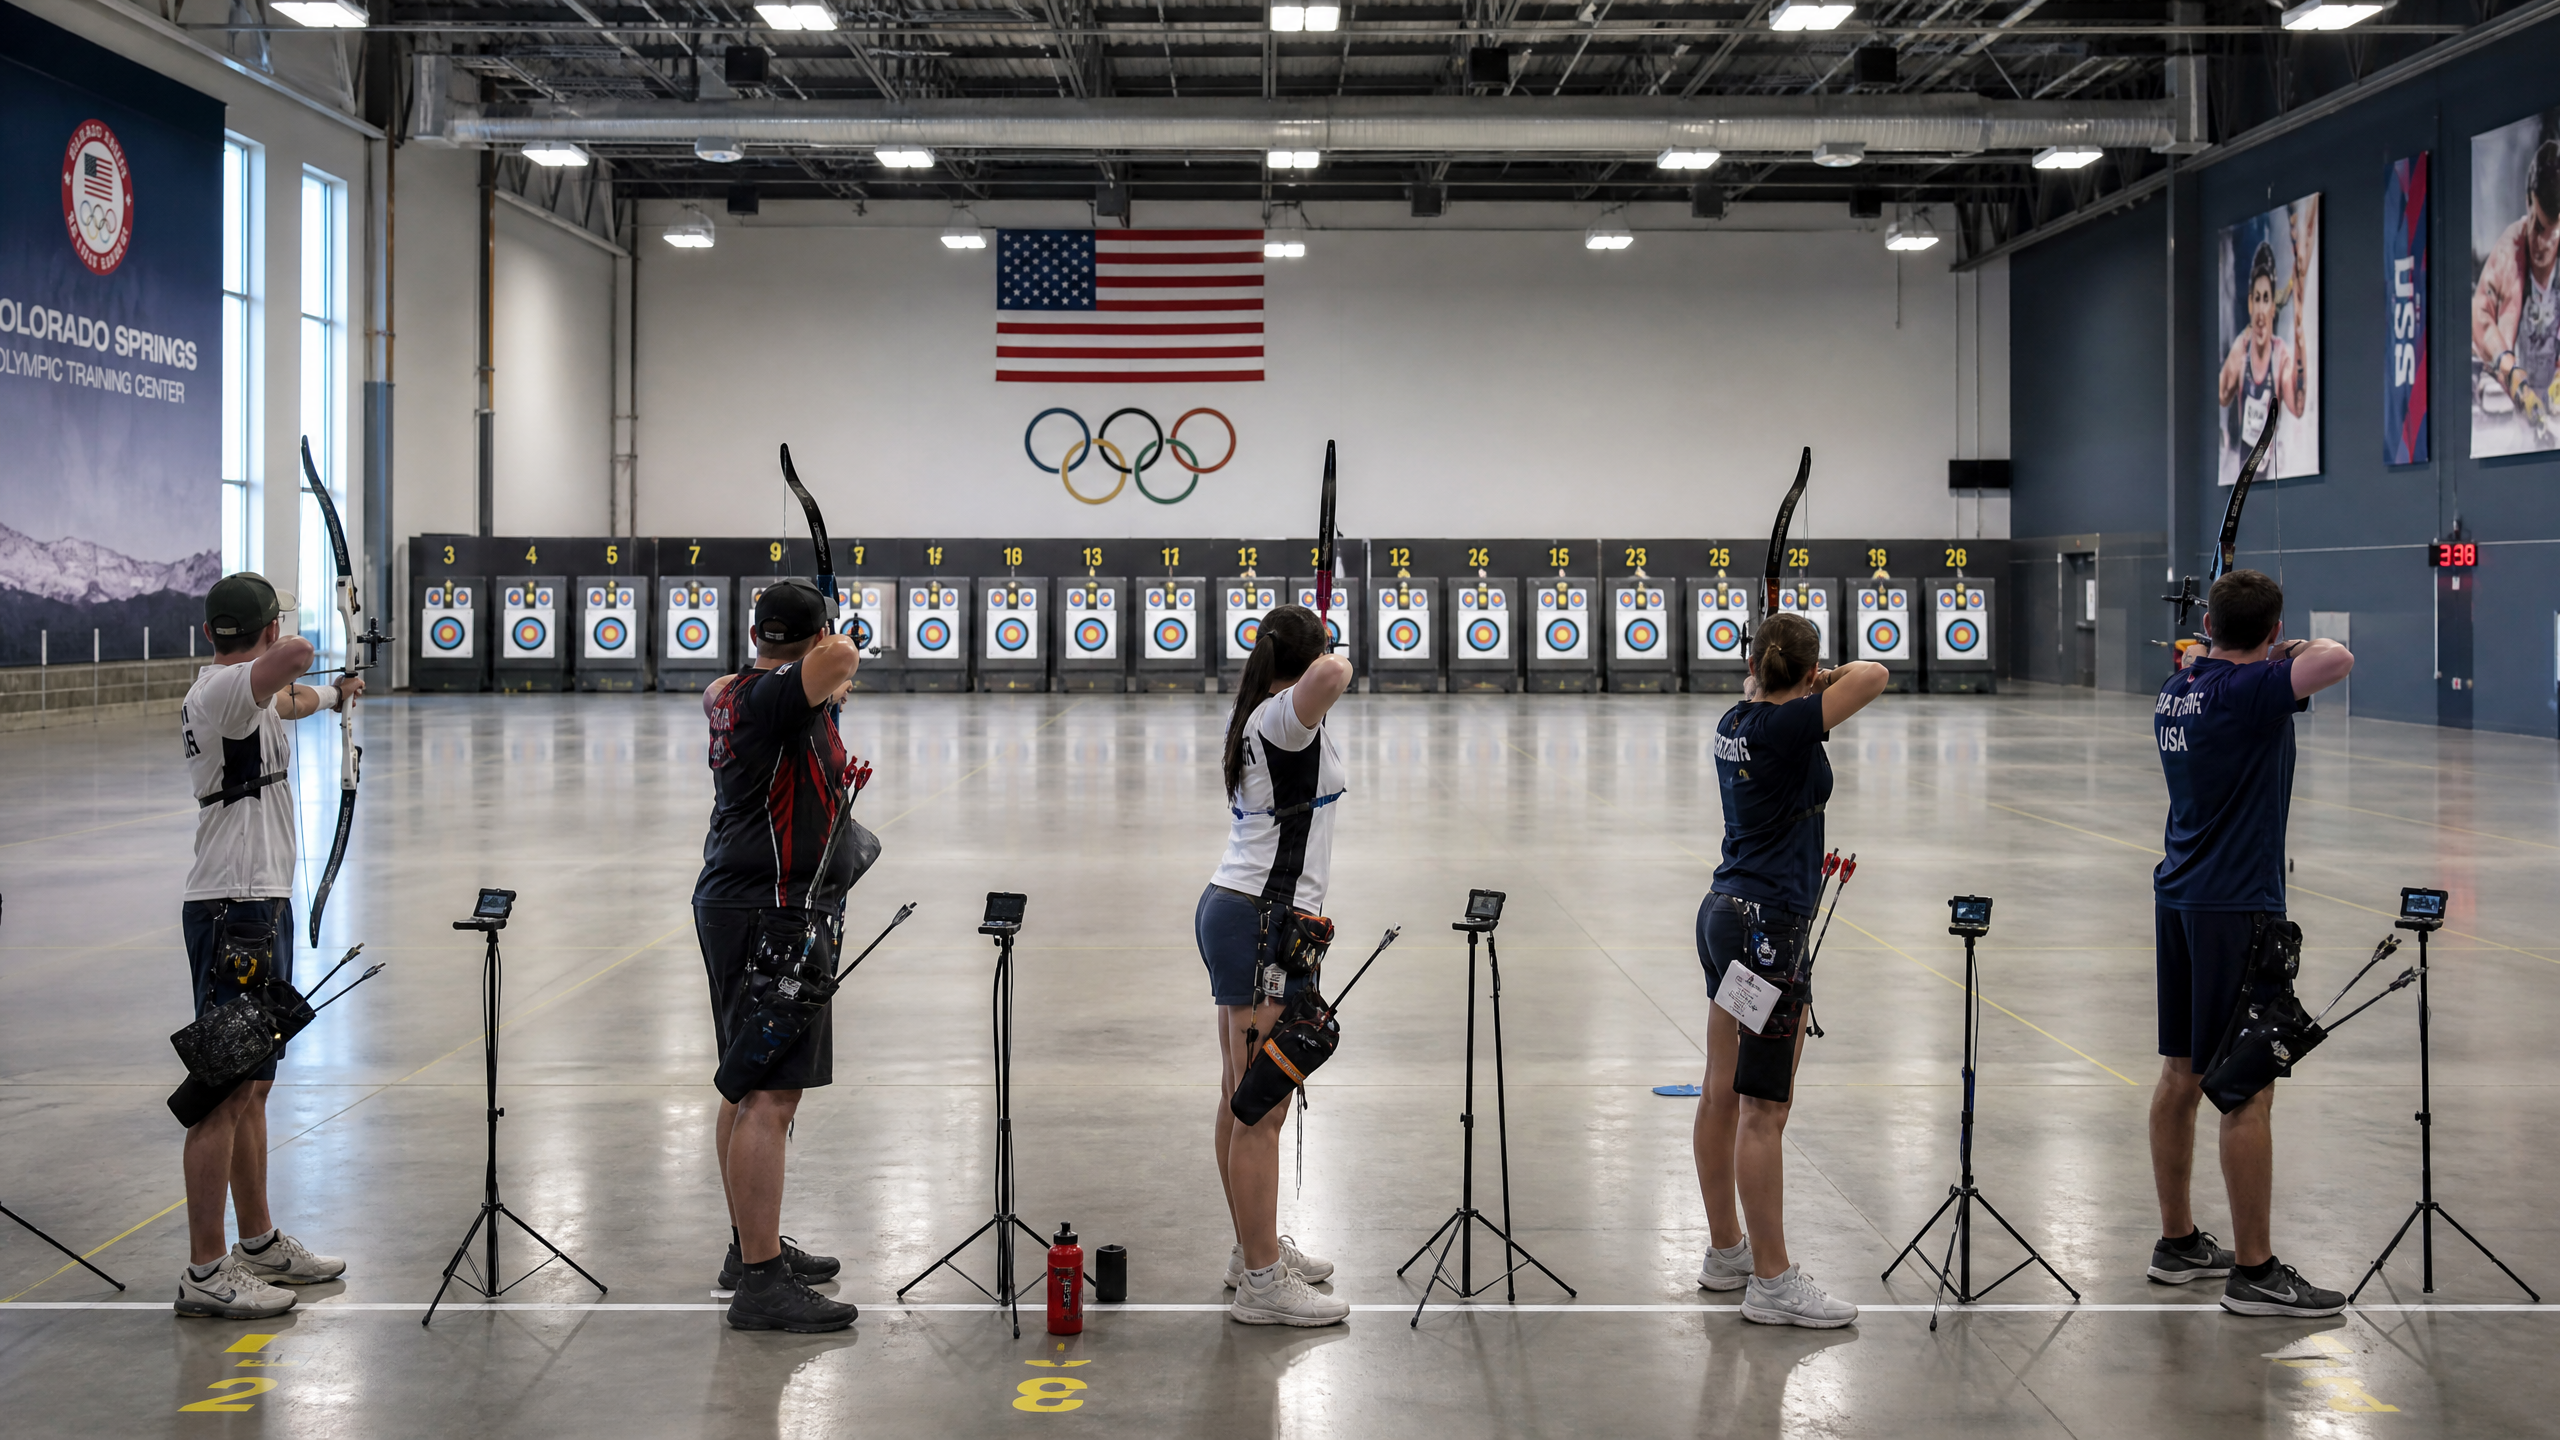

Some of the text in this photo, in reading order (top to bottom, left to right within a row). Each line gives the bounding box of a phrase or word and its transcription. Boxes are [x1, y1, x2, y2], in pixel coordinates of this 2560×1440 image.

[114, 325, 197, 371] SPRINGS
[66, 360, 132, 394] TRAINING
[135, 374, 185, 404] CENTER
[443, 546, 455, 565] 3
[525, 546, 538, 564] 4
[606, 546, 618, 565] 5
[688, 546, 701, 565] 7
[769, 542, 782, 562] 9
[1082, 547, 1103, 566] 13
[1389, 548, 1411, 567] 12
[1468, 548, 1490, 567] 26
[1625, 548, 1647, 567] 23
[2160, 726, 2188, 752] USA
[177, 1376, 279, 1412] 2
